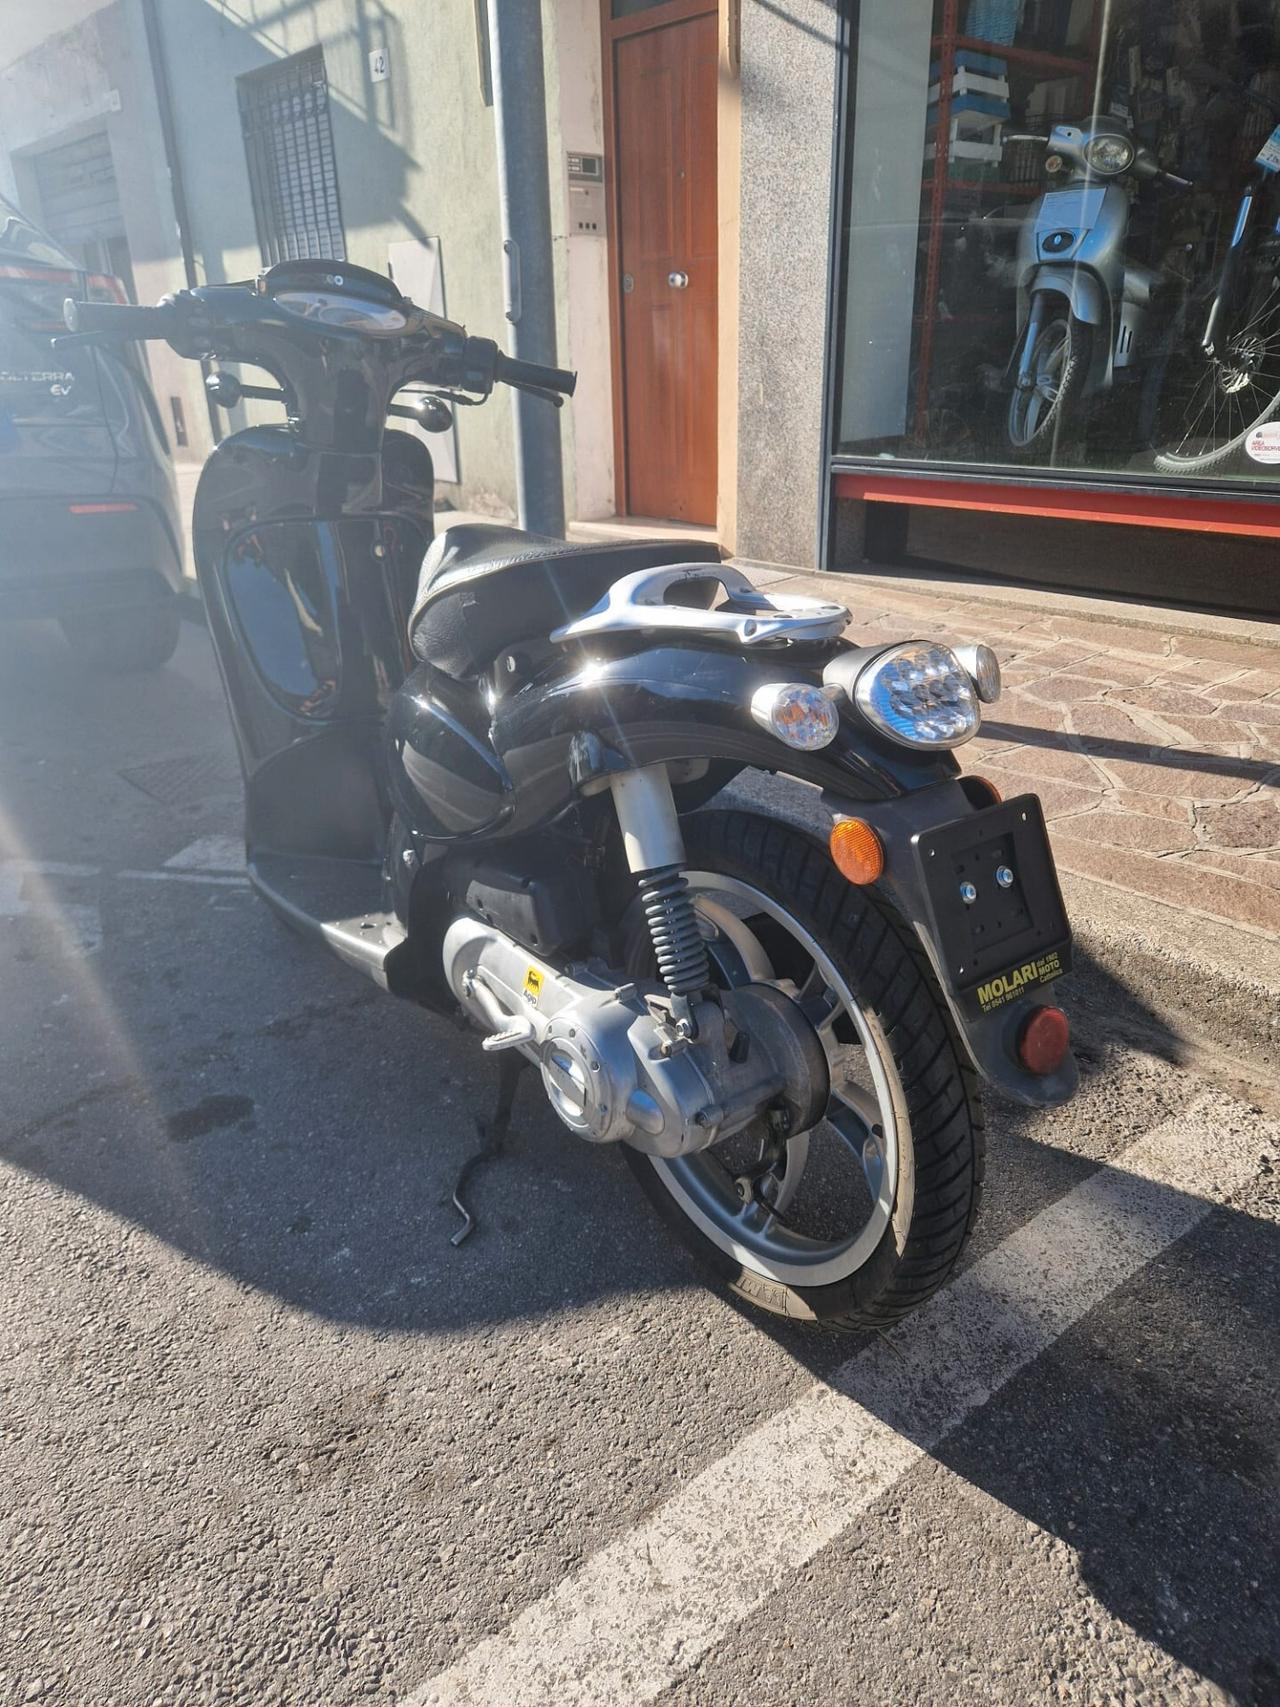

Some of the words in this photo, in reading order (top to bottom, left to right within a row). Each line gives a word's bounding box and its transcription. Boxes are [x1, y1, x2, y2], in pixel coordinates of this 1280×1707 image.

[374, 56, 385, 74] 42
[50, 383, 72, 396] EV
[1038, 959, 1060, 976] MOTO
[977, 962, 1039, 1005] MOLARI
